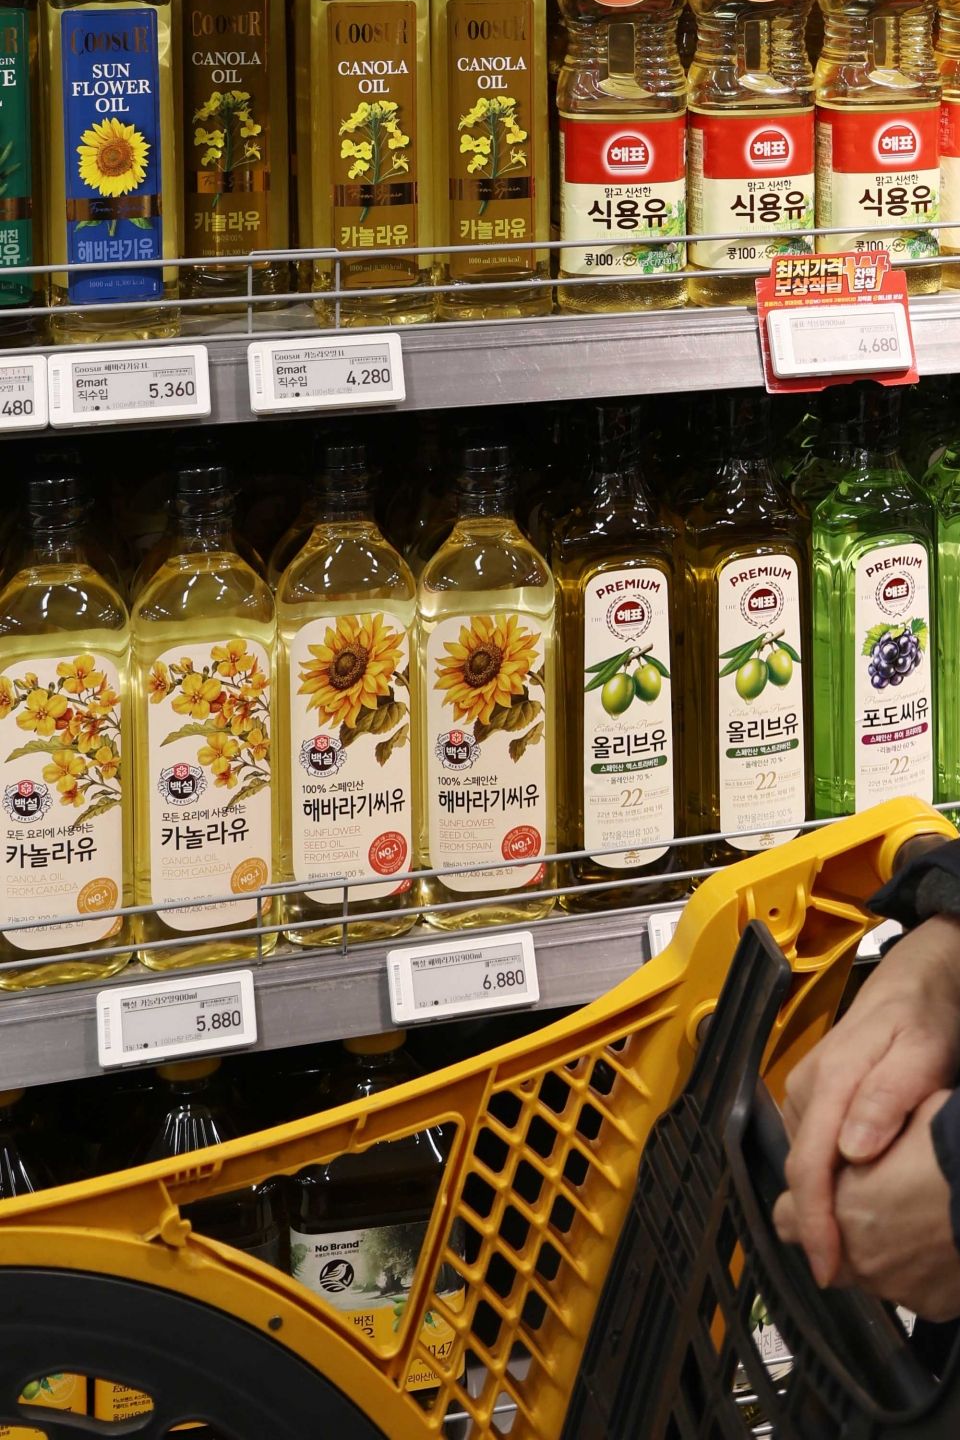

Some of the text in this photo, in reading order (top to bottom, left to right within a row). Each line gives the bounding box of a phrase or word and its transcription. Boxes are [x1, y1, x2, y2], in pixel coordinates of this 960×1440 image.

[192, 51, 262, 66] CANOLA
[457, 56, 527, 72] CANOLA
[92, 63, 131, 79] SUN
[211, 69, 242, 83] OIL
[337, 60, 409, 76] CANOLA
[72, 79, 152, 96] FLOWER
[358, 79, 390, 94] OIL
[477, 75, 508, 90] OIL
[95, 97, 130, 113] OIL
[753, 139, 786, 156] 해표
[882, 134, 913, 151] 해표
[610, 145, 645, 163] 해표
[747, 179, 792, 191] 맑고 신선한
[875, 173, 919, 185] 맑고 신선한
[604, 187, 652, 198] 맑고 신선한
[858, 185, 932, 217] 식용유
[587, 198, 668, 230] 식용유
[730, 191, 806, 223] 식용유
[194, 210, 261, 232] 카놀라유
[460, 217, 527, 240] 카놀라유
[340, 224, 409, 248] 카놀라유
[78, 238, 153, 263] 해바라기유
[775, 258, 876, 279] 최저가격 차액
[774, 276, 876, 297] 보상적립 보상
[858, 337, 898, 354] 4,680
[276, 365, 307, 375] emart
[346, 368, 390, 386] 4,280
[76, 377, 108, 388] emart
[149, 381, 195, 399] 5,360
[278, 376, 308, 388] 직수입
[78, 389, 109, 401] 직수입
[865, 556, 923, 578] PREMIUM
[730, 566, 792, 588] PREMIUM
[595, 579, 661, 599] PREMIUM
[862, 697, 929, 729] 포도씨유
[726, 713, 799, 743] 올리브유
[591, 729, 668, 759] 올리브유
[170, 780, 193, 794] 백설
[302, 780, 364, 794] 100% 스페인산
[437, 774, 498, 786] 100% 스페인산
[14, 797, 38, 811] 백설
[303, 788, 406, 822] 해바라기씨유
[438, 783, 540, 813] 해바라기씨유
[162, 804, 246, 823] 모든 요리에 사용하는
[6, 822, 94, 841] 모든 요리에 사용하는
[439, 818, 494, 828] SUNFLOWER
[161, 818, 249, 850] 카놀라유
[303, 826, 361, 838] SUNFLOWER
[439, 831, 462, 839] SEED
[6, 836, 97, 869] 카놀라유
[304, 840, 327, 850] SEED
[378, 843, 399, 859] NO.1
[439, 842, 492, 851] FROM SPAIN
[304, 850, 359, 861] FROM SPAIN
[191, 863, 232, 876] CANADA
[35, 882, 79, 895] CANADA
[482, 969, 525, 990] 6,880
[196, 1010, 241, 1032] 5,880
[315, 1244, 329, 1253] No
[330, 1240, 360, 1251] Brand
